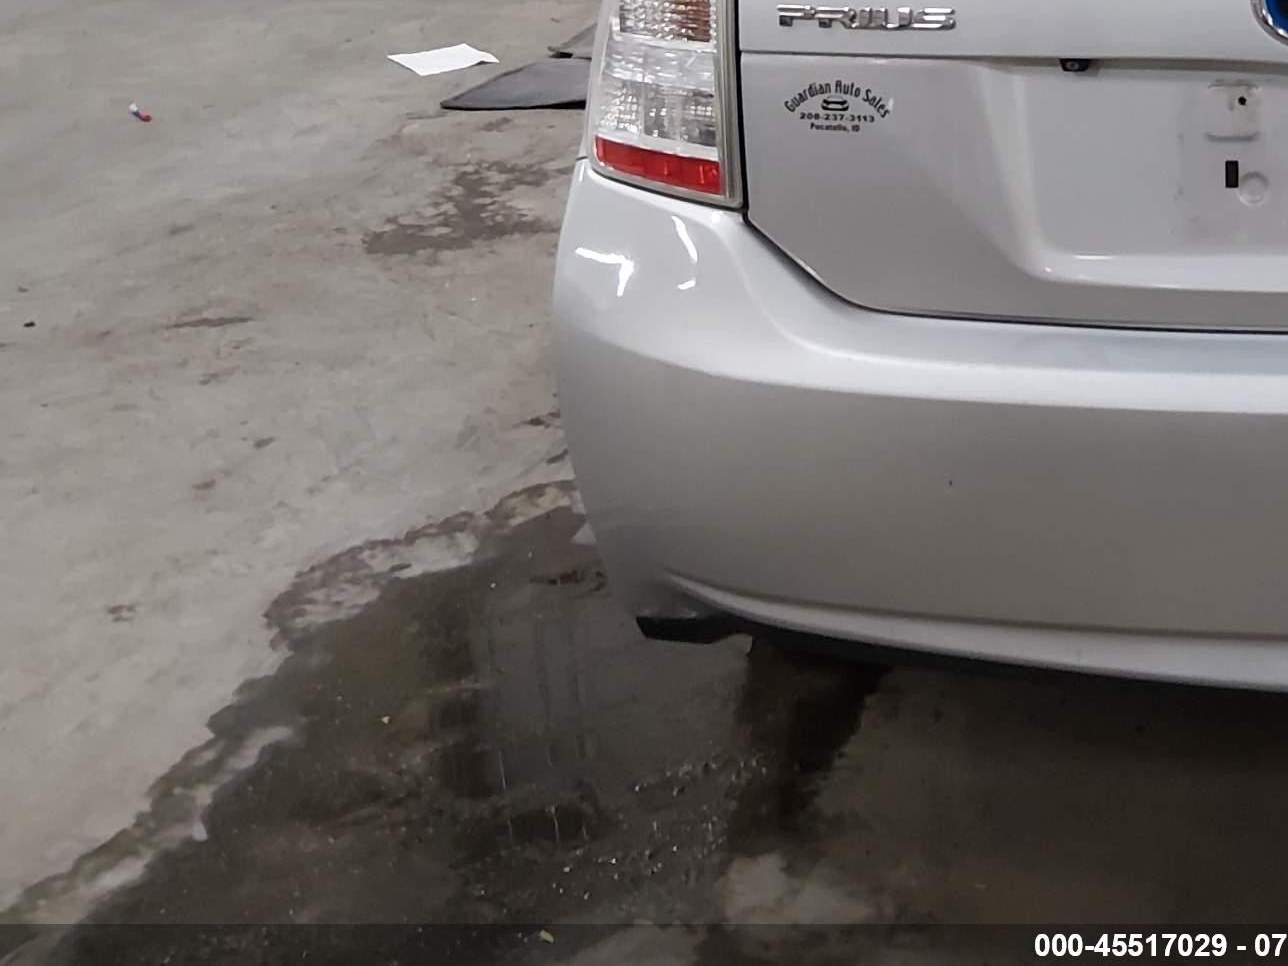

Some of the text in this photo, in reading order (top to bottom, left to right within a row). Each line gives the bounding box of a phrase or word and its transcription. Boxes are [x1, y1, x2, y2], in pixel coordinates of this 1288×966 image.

[776, 4, 956, 30] PRIUS
[784, 80, 890, 118] Guardian Auto Sales
